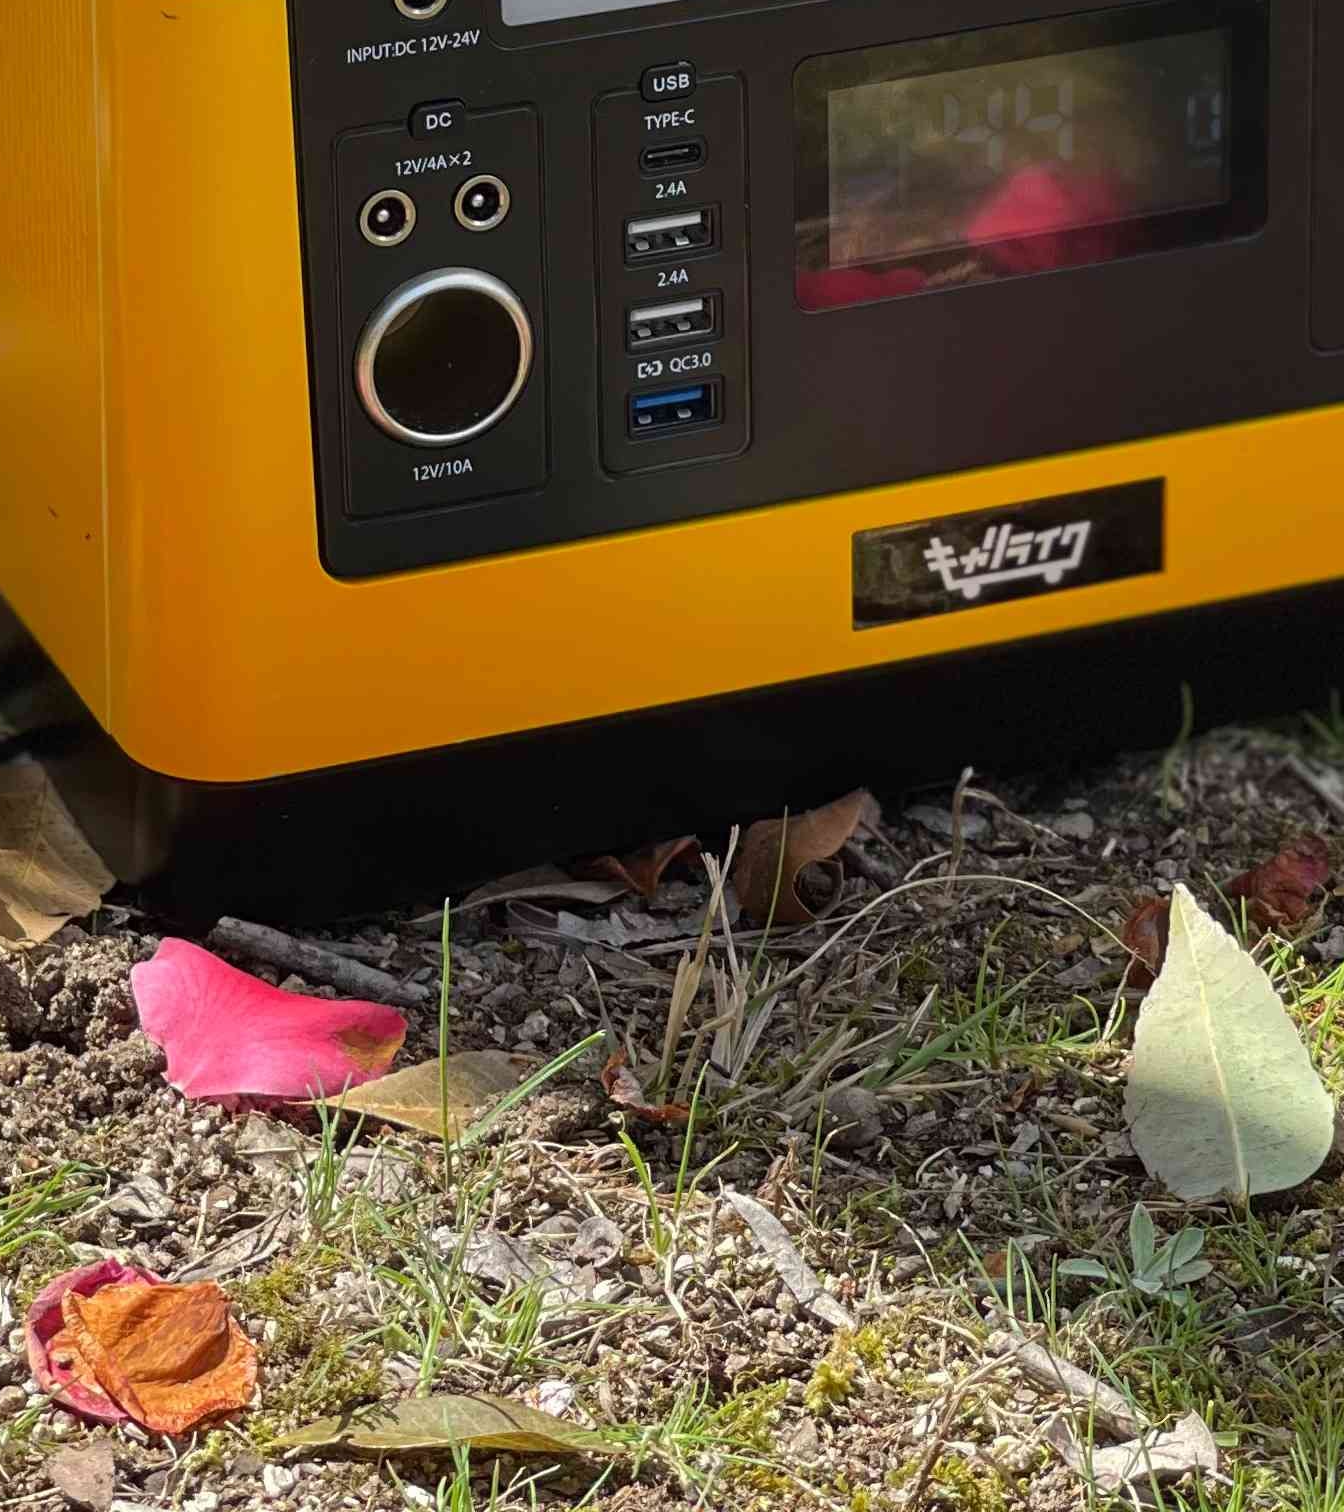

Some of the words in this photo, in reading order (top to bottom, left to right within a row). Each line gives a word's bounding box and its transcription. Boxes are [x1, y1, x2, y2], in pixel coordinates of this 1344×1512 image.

[346, 39, 417, 64] INPUT:DC
[420, 29, 481, 53] 12V-24V
[653, 73, 690, 93] USB
[425, 112, 452, 130] DC
[644, 108, 695, 130] TYPE-C
[655, 180, 687, 199] 2.4A
[657, 268, 689, 287] 2.4A
[669, 352, 712, 373] QC3.0
[412, 458, 473, 481] 12V/10A
